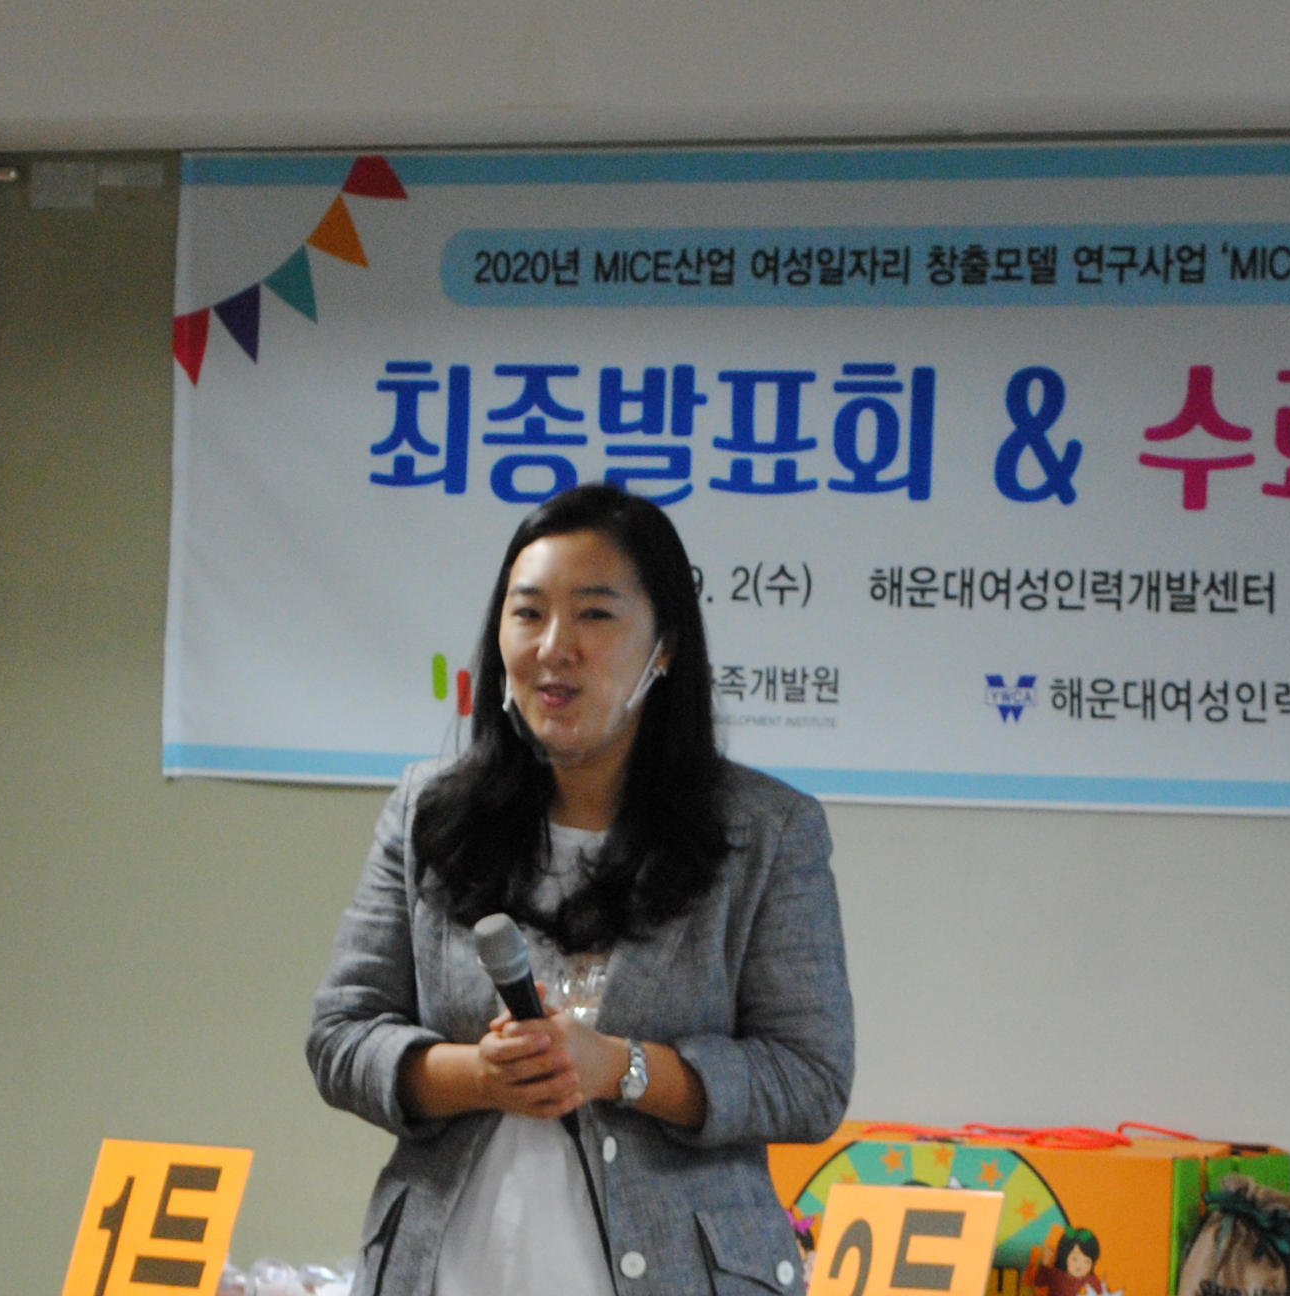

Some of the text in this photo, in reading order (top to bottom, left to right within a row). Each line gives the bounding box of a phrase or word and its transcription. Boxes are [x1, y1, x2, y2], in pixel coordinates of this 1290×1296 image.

[474, 247, 581, 287] 2020년
[593, 247, 736, 287] MICE산업
[750, 246, 911, 287] 여성일자리
[926, 244, 1058, 287] 창출모델
[1073, 243, 1207, 285] 연구사업
[369, 360, 937, 508] 최종발표회
[994, 365, 1083, 506] &
[730, 562, 813, 607] 2(수)
[869, 565, 1276, 616] 해운대여성인력개발센터
[712, 665, 840, 704] 족개발원
